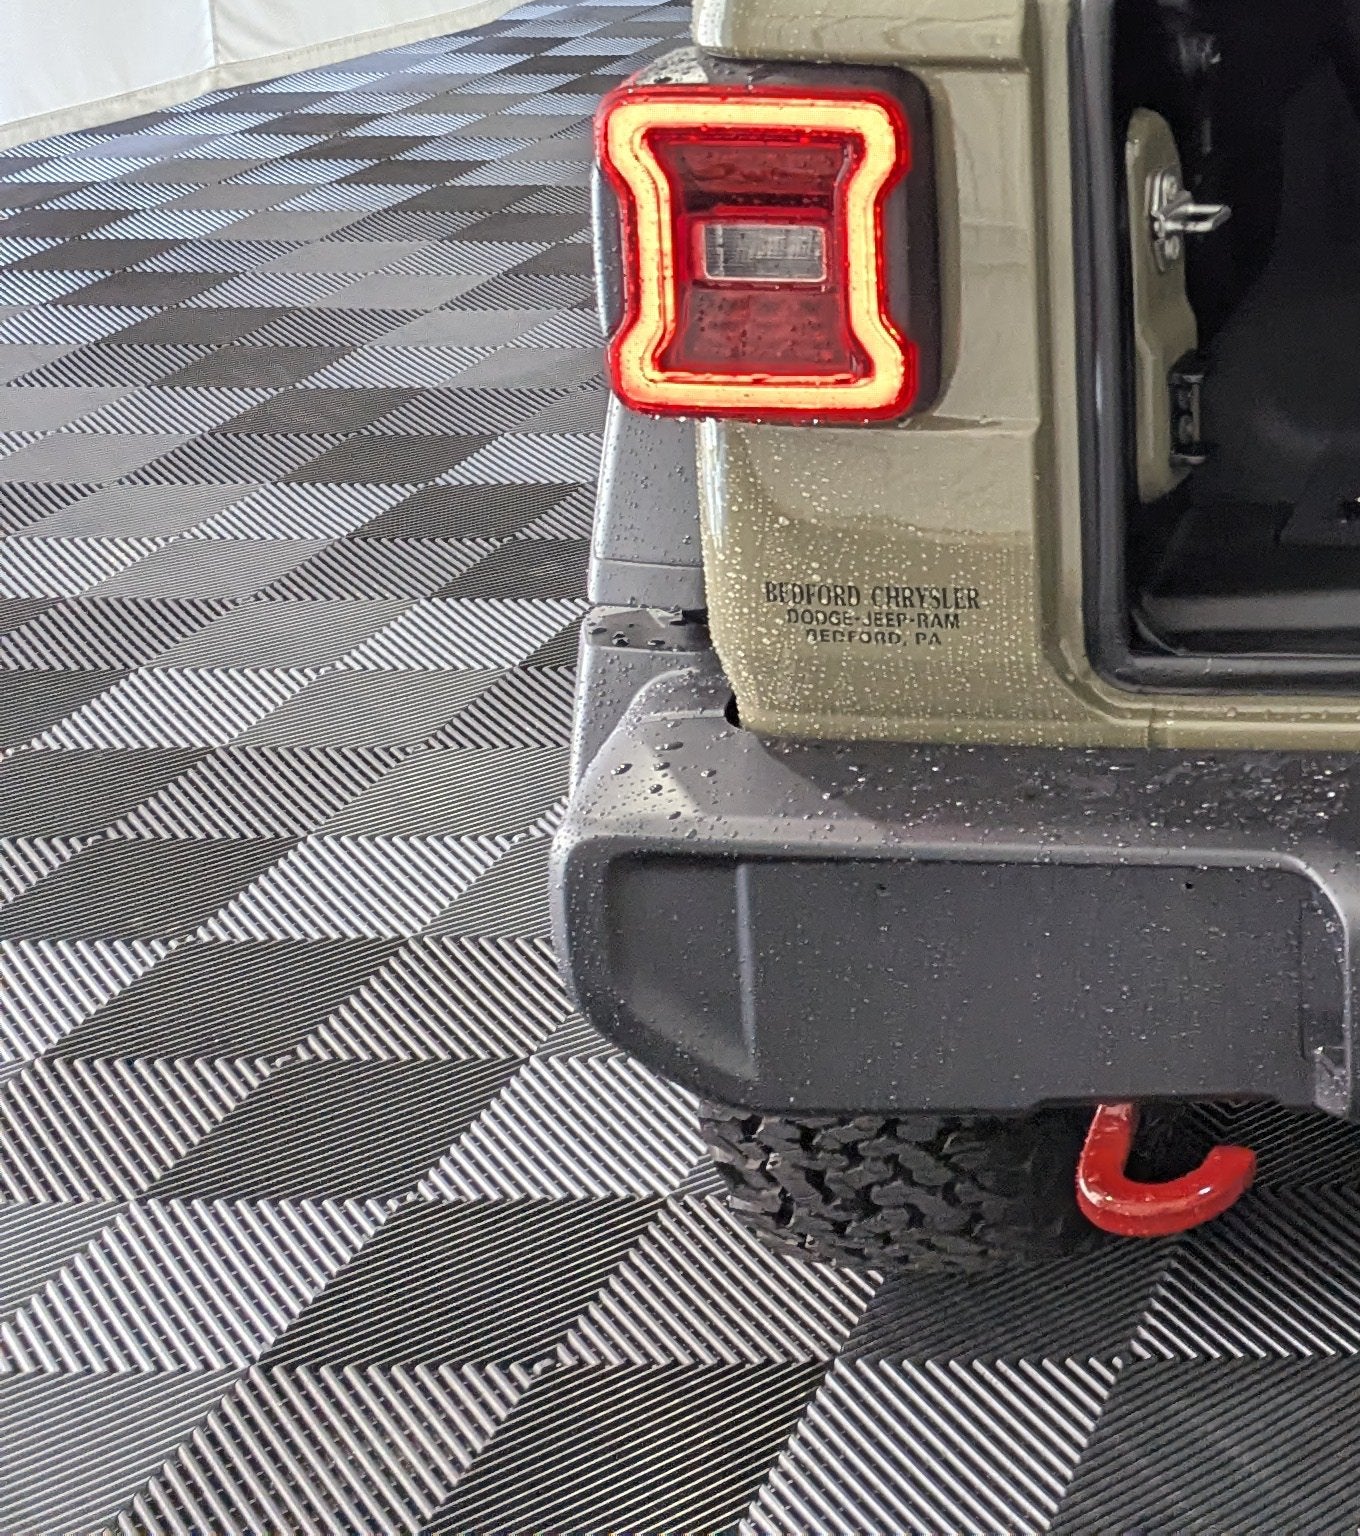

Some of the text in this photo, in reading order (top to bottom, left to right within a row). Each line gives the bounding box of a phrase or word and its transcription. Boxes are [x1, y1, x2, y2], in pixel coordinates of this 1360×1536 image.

[765, 581, 980, 610] BEDFORD CHRYSLER
[787, 608, 960, 629] DODGE-JEEP-RAM
[916, 632, 942, 646] PA
